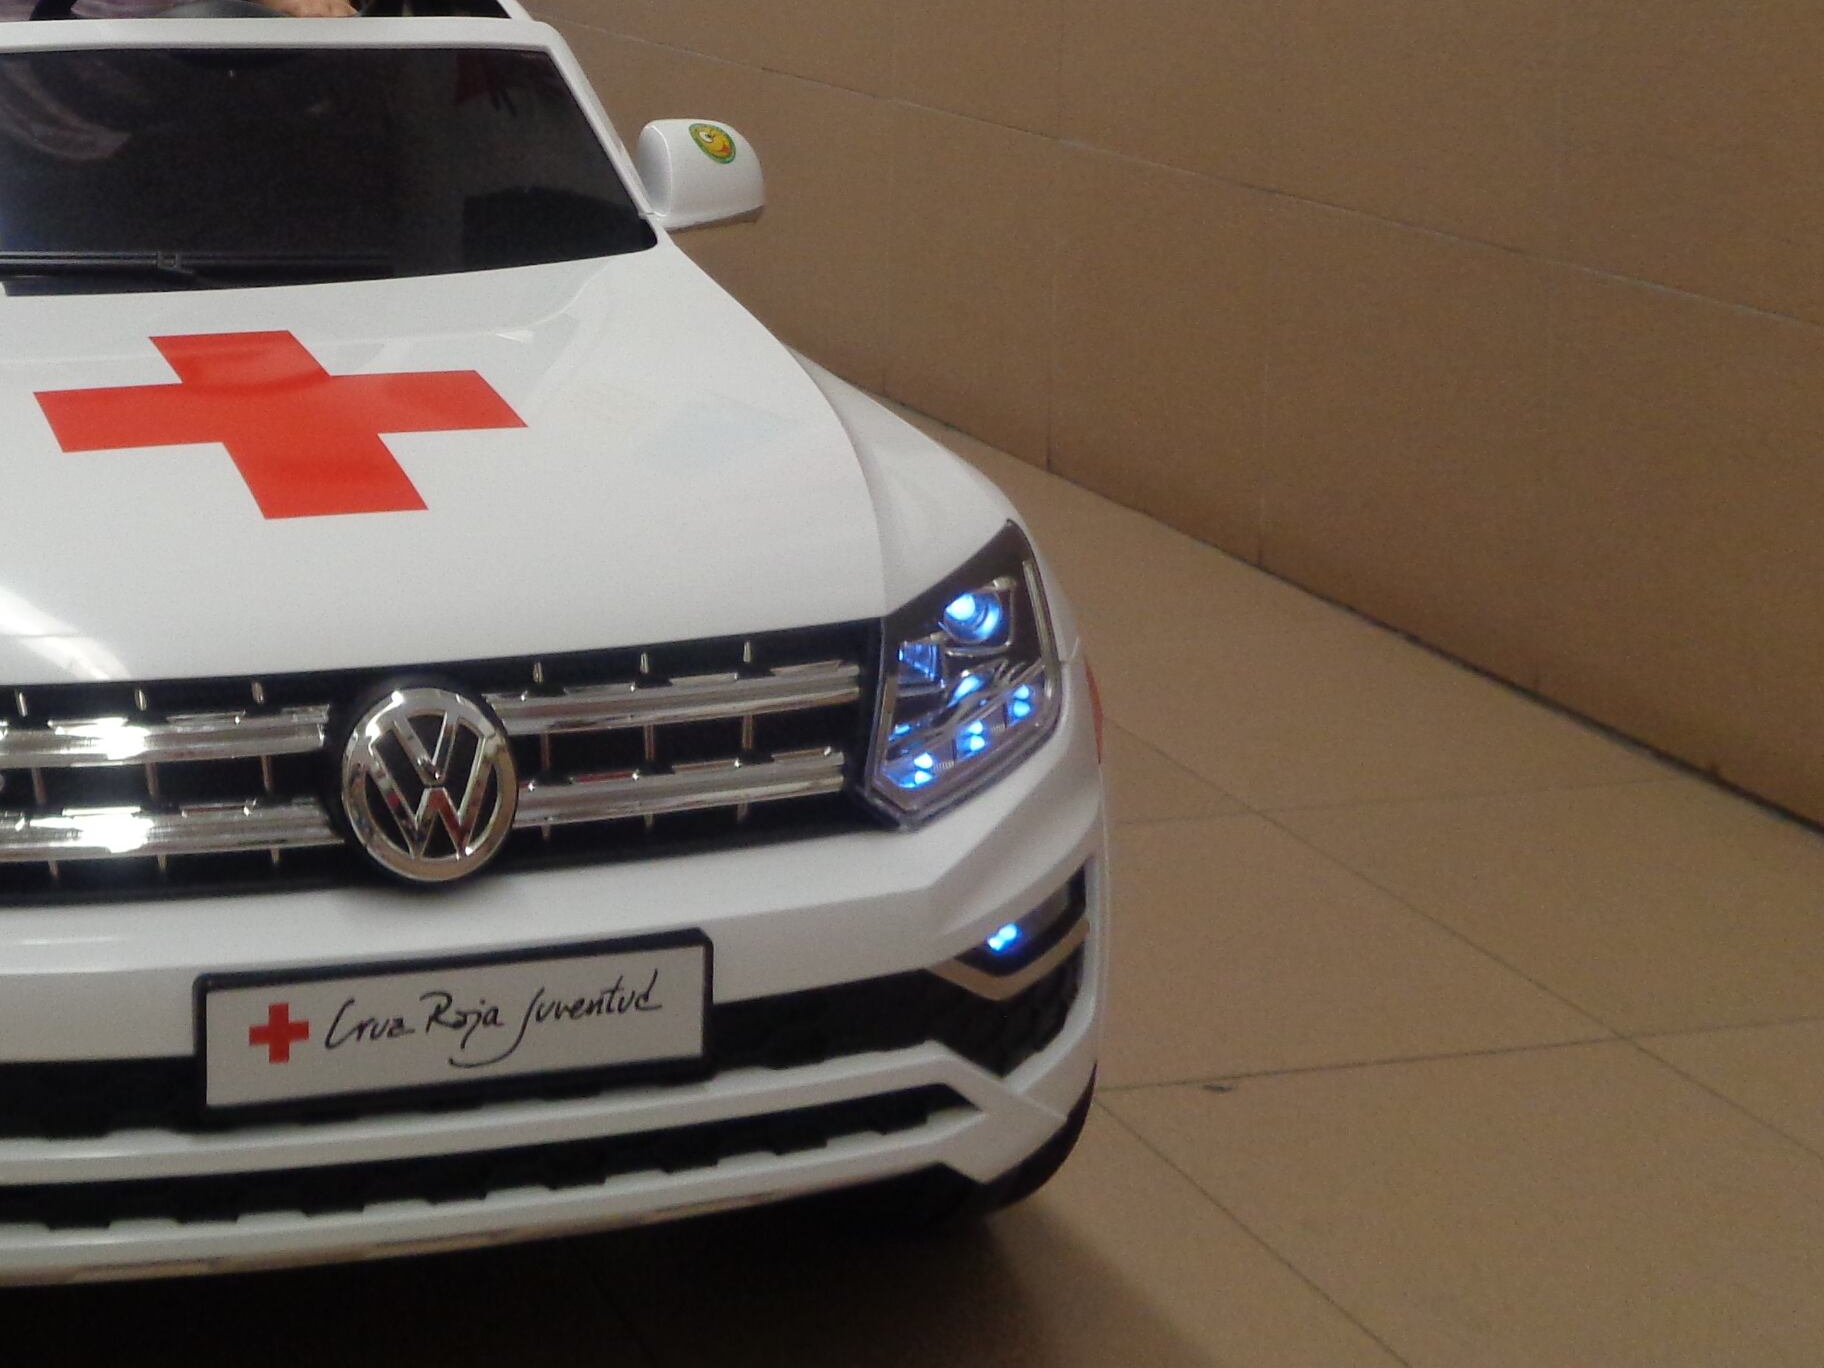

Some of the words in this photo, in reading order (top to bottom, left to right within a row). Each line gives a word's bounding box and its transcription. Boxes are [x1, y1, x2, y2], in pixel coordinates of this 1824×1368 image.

[324, 997, 415, 1050] Cruz
[419, 990, 504, 1050] Roja
[448, 968, 664, 1069] Juventud
